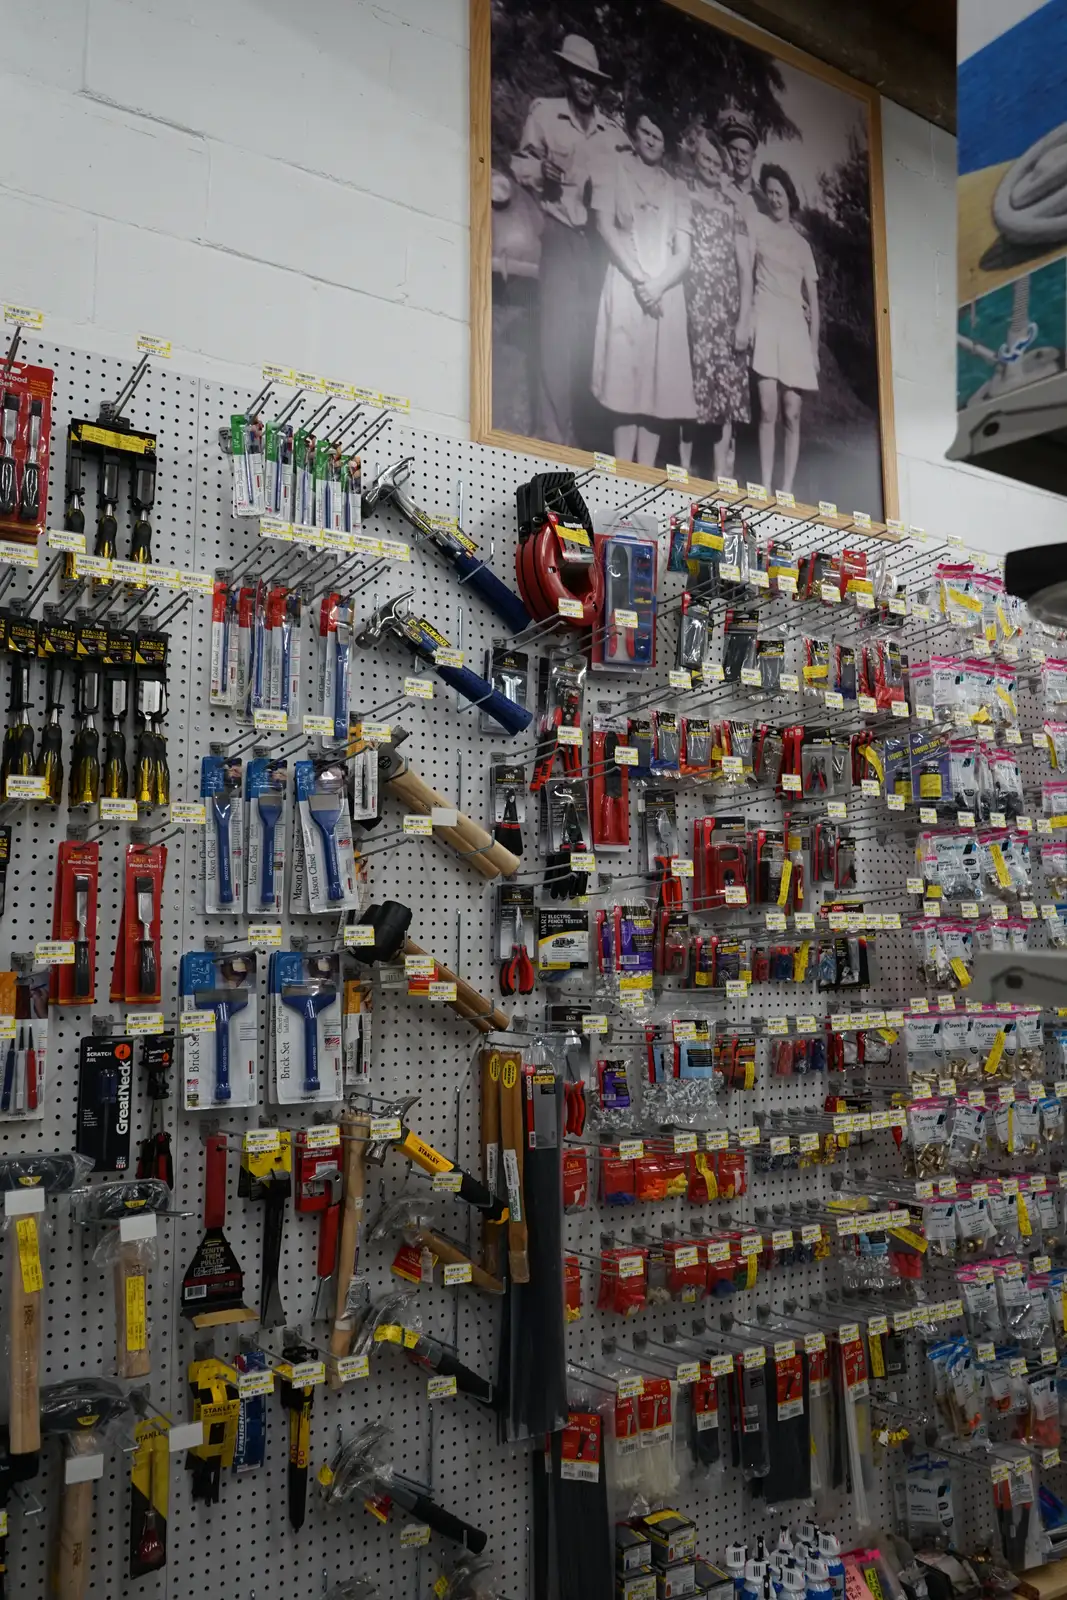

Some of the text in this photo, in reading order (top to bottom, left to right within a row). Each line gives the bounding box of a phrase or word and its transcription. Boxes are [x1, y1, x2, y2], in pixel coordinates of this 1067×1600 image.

[4, 373, 28, 386] Wood
[12, 627, 36, 638] STANLEY
[51, 629, 76, 641] STANLEY
[82, 631, 108, 641] STANLEY
[109, 642, 132, 652] TANLEY
[140, 642, 164, 653] STANLEY
[271, 668, 280, 696] Cold Chisel
[208, 840, 216, 880] Mason Chisel
[250, 844, 258, 885] Mason Chisel
[293, 850, 304, 900] Mason Chisel
[308, 854, 320, 900] Mason Chisel
[189, 1049, 200, 1072] Brick
[280, 1042, 290, 1079] Brick Set
[115, 1061, 131, 1134] GreatNeck
[418, 1146, 440, 1165] STANLEY
[28, 1166, 34, 1174] 4
[133, 1190, 139, 1198] 3
[86, 1404, 92, 1413] 3
[204, 1404, 236, 1415] STANLEY
[136, 1428, 168, 1443] STANLEY
